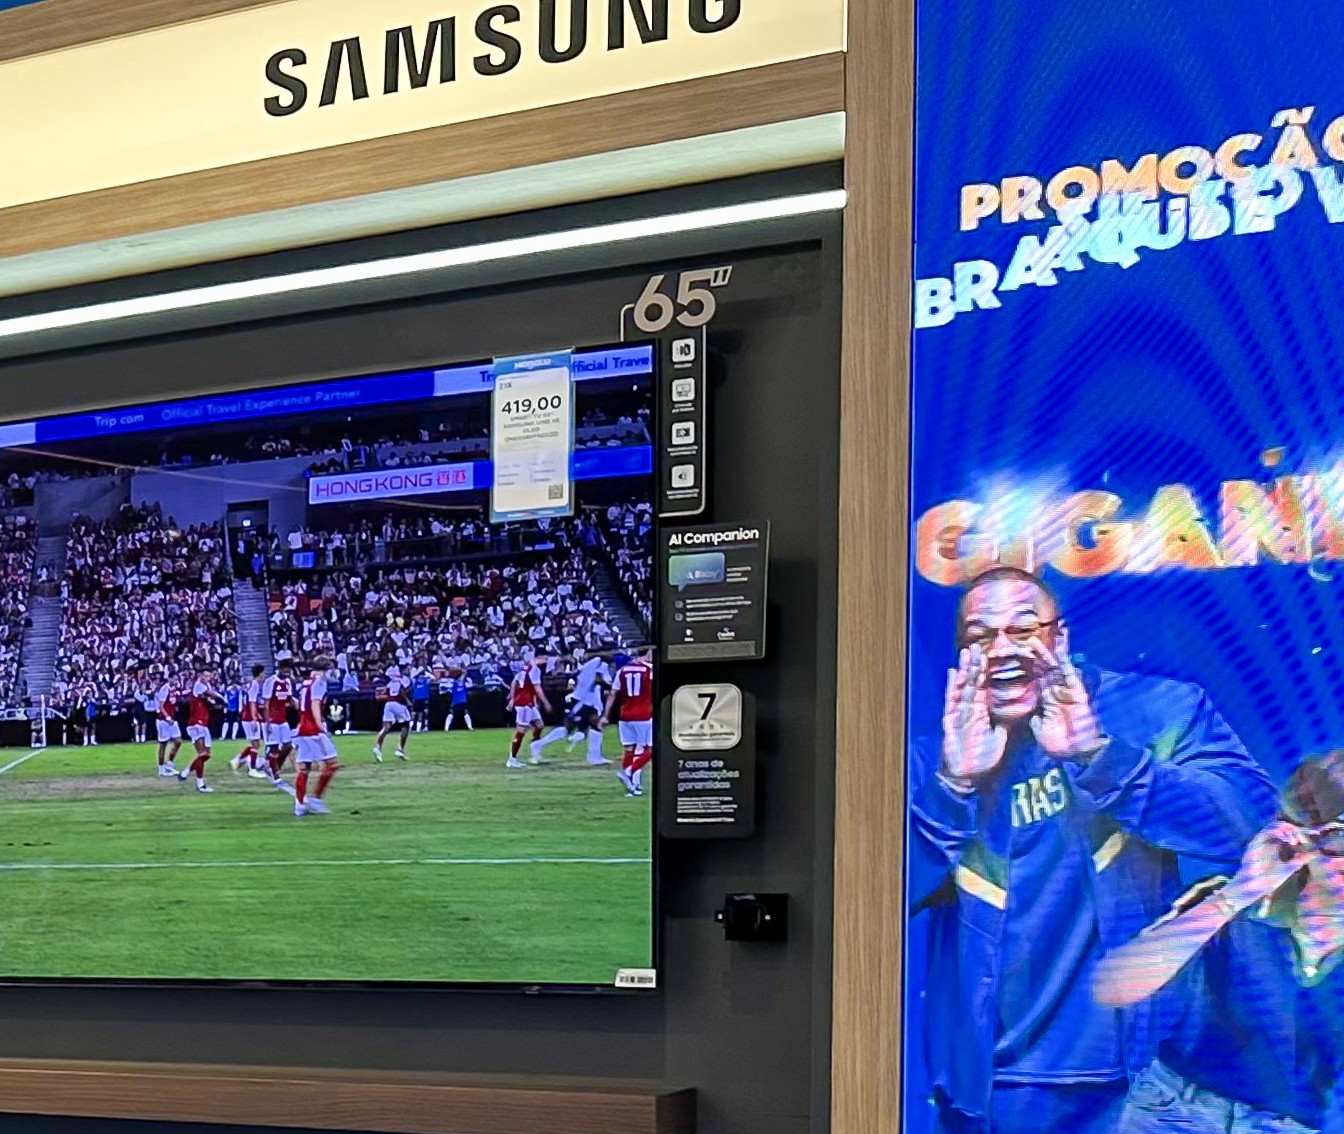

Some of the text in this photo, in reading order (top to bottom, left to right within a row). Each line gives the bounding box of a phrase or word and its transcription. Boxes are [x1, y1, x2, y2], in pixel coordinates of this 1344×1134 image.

[501, 395, 562, 414] 419,00
[668, 527, 760, 546] AI Companion
[697, 692, 717, 720] 7
